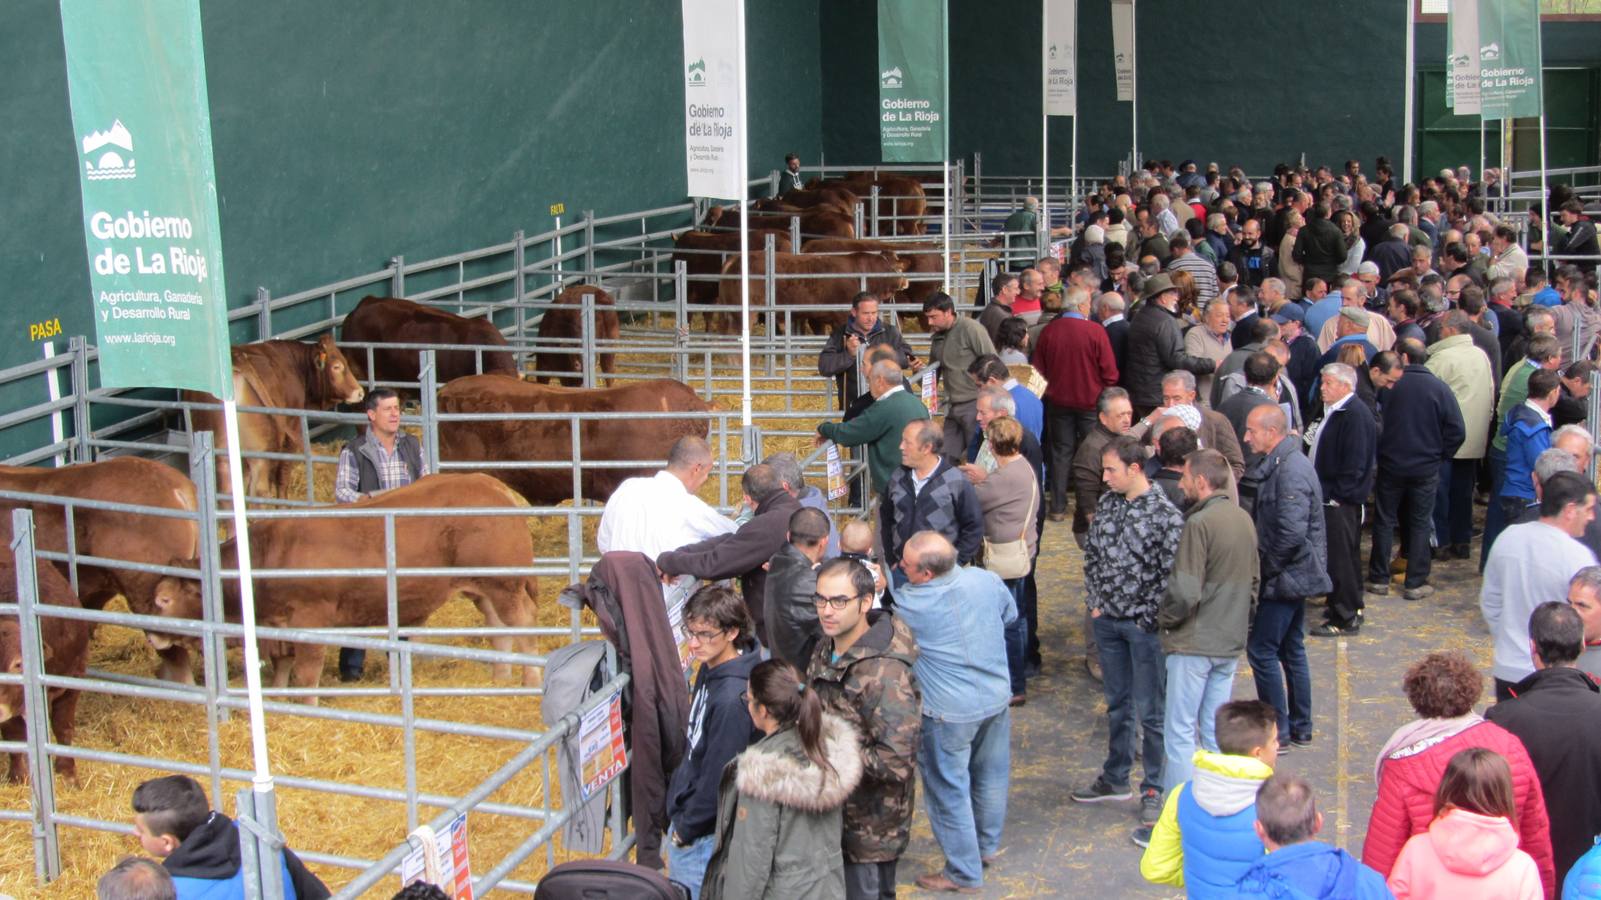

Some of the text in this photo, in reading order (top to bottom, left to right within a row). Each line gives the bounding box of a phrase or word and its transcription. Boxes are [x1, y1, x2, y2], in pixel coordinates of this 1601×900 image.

[1481, 67, 1525, 78] Gobierno
[1481, 76, 1534, 88] de La Rioja
[688, 103, 724, 118] Gobierno
[882, 98, 930, 110] Gobierno
[882, 111, 940, 123] de La Rioja
[689, 122, 701, 137] de
[703, 122, 712, 137] La
[91, 211, 192, 239] Gobierno
[95, 247, 207, 282] de La Rioja
[100, 290, 162, 305] Agricultura,
[101, 307, 190, 322] y Desarrollo Rural
[30, 318, 62, 341] PASA
[104, 332, 176, 346] www.larioja.org
[582, 760, 624, 796] VENTA
